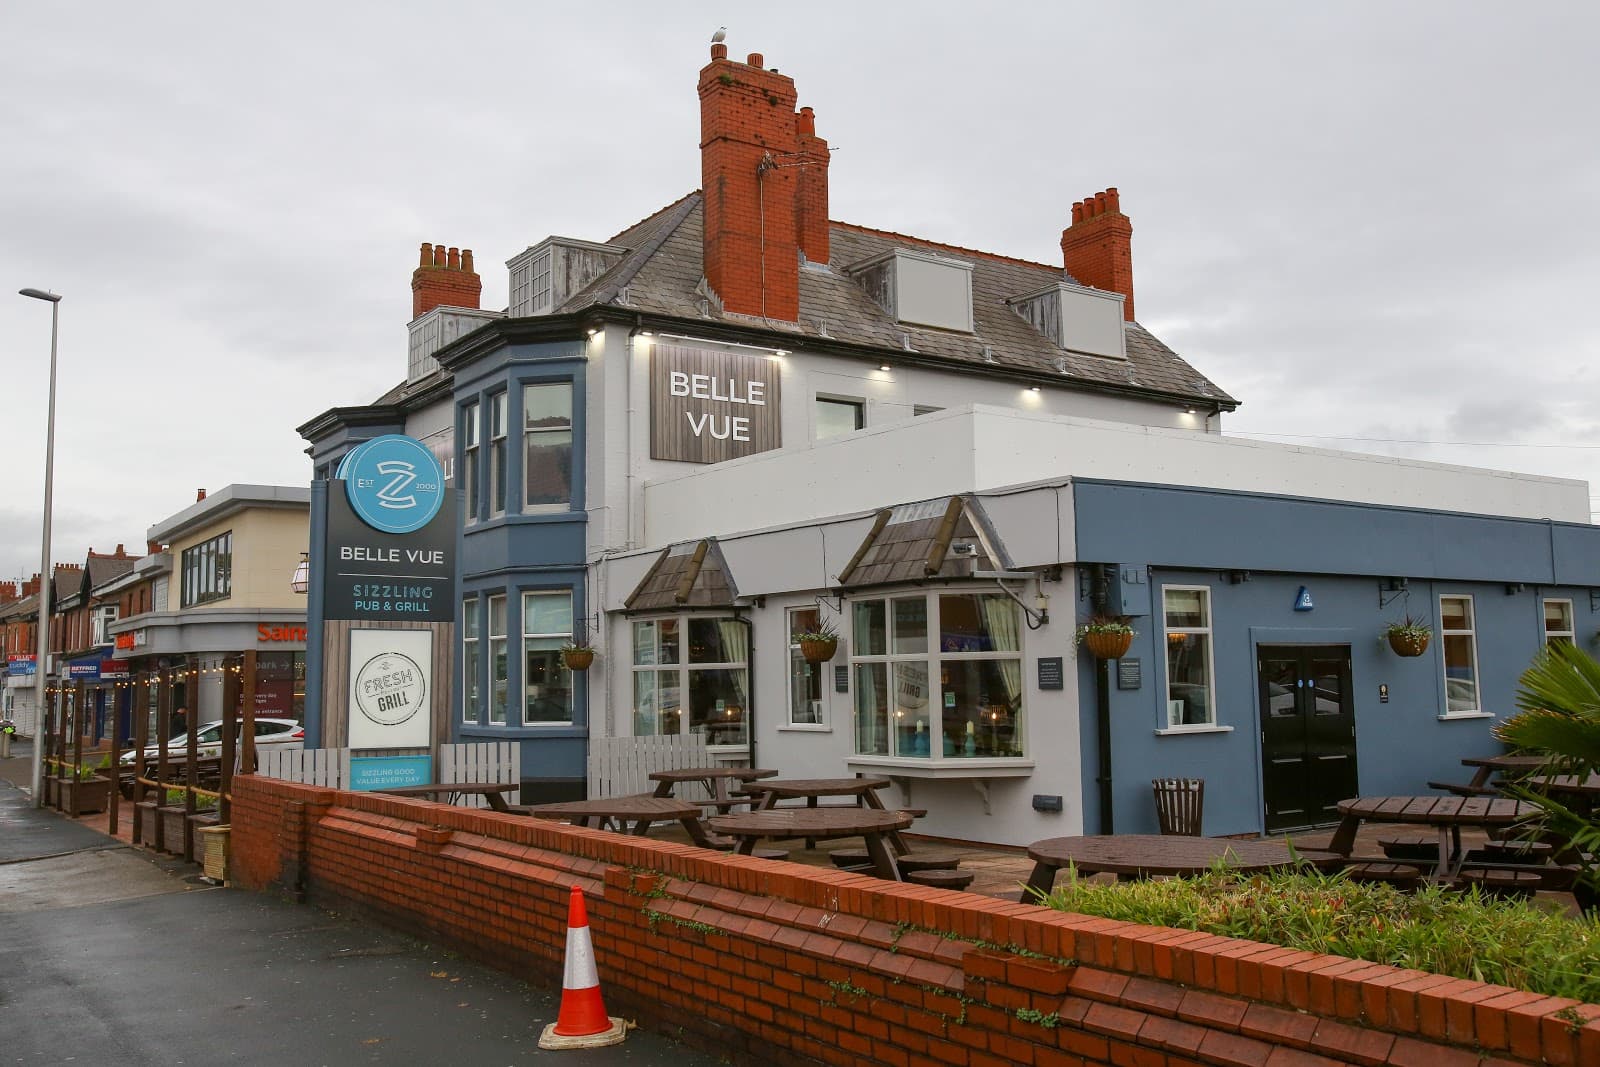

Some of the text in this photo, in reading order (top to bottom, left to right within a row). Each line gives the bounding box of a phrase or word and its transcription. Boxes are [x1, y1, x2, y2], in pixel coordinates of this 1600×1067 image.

[670, 371, 765, 406] BELLE
[686, 411, 750, 441] VUE
[340, 546, 444, 564] BELLE VUE
[353, 584, 433, 598] SIZZLING
[355, 600, 430, 612] PUB & GRILL
[364, 669, 413, 694] FRESH
[377, 691, 410, 712] GRILL
[361, 768, 393, 776] SIZZLING
[380, 776, 404, 784] EVERY
